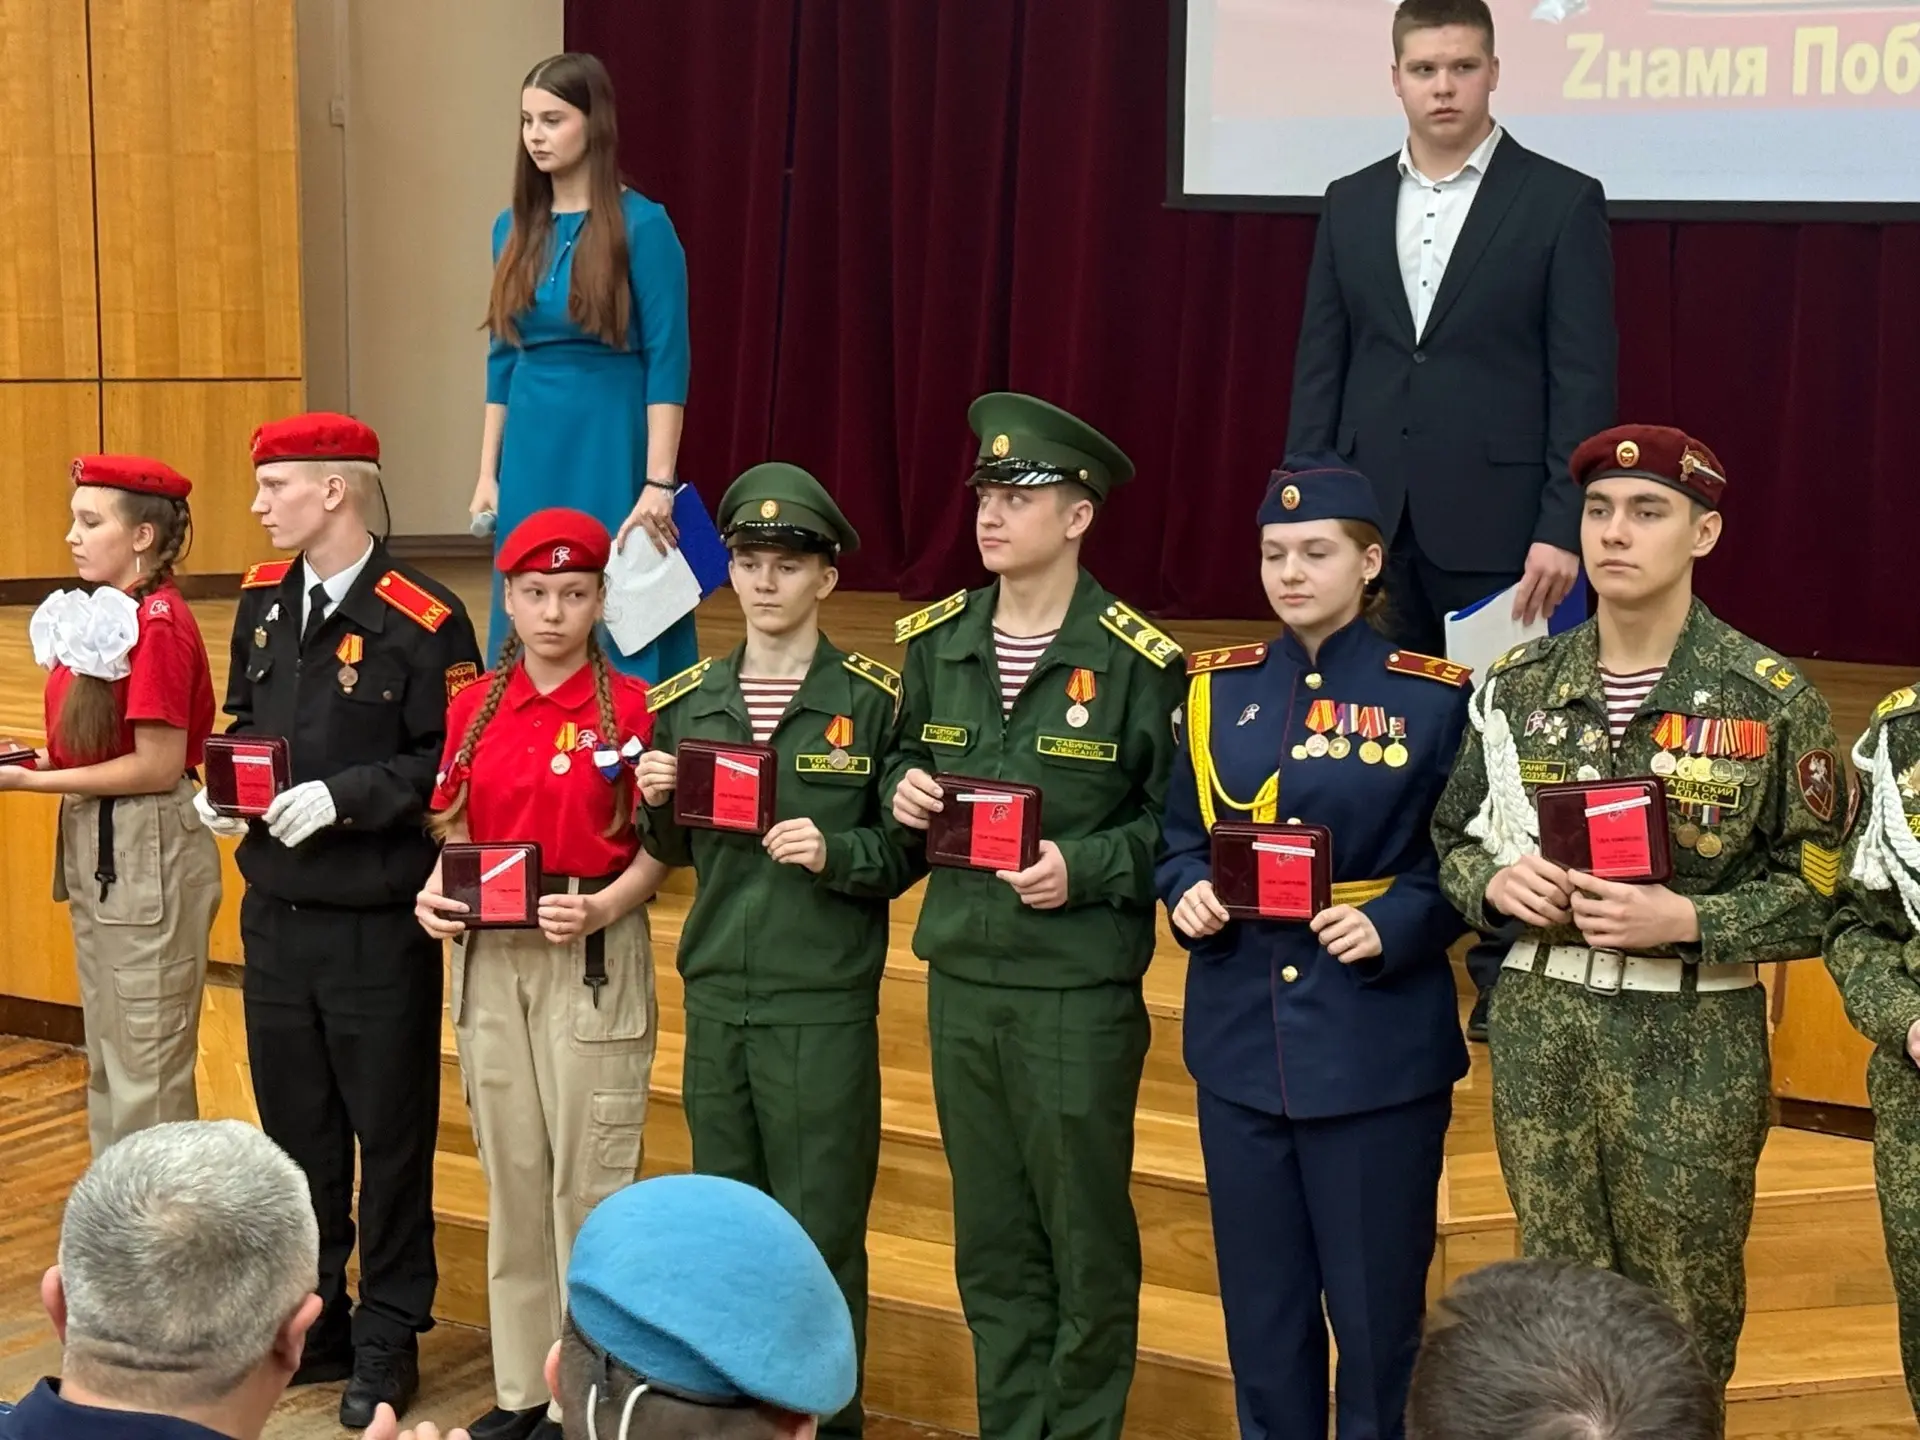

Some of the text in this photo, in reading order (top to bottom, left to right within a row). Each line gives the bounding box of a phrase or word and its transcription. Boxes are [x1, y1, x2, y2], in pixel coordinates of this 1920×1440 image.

[1562, 32, 1767, 99] Zнамя
[421, 603, 445, 626] КК
[1663, 777, 1735, 797] АДЕТСКИЙ
[1675, 787, 1720, 802] КЛАСС
